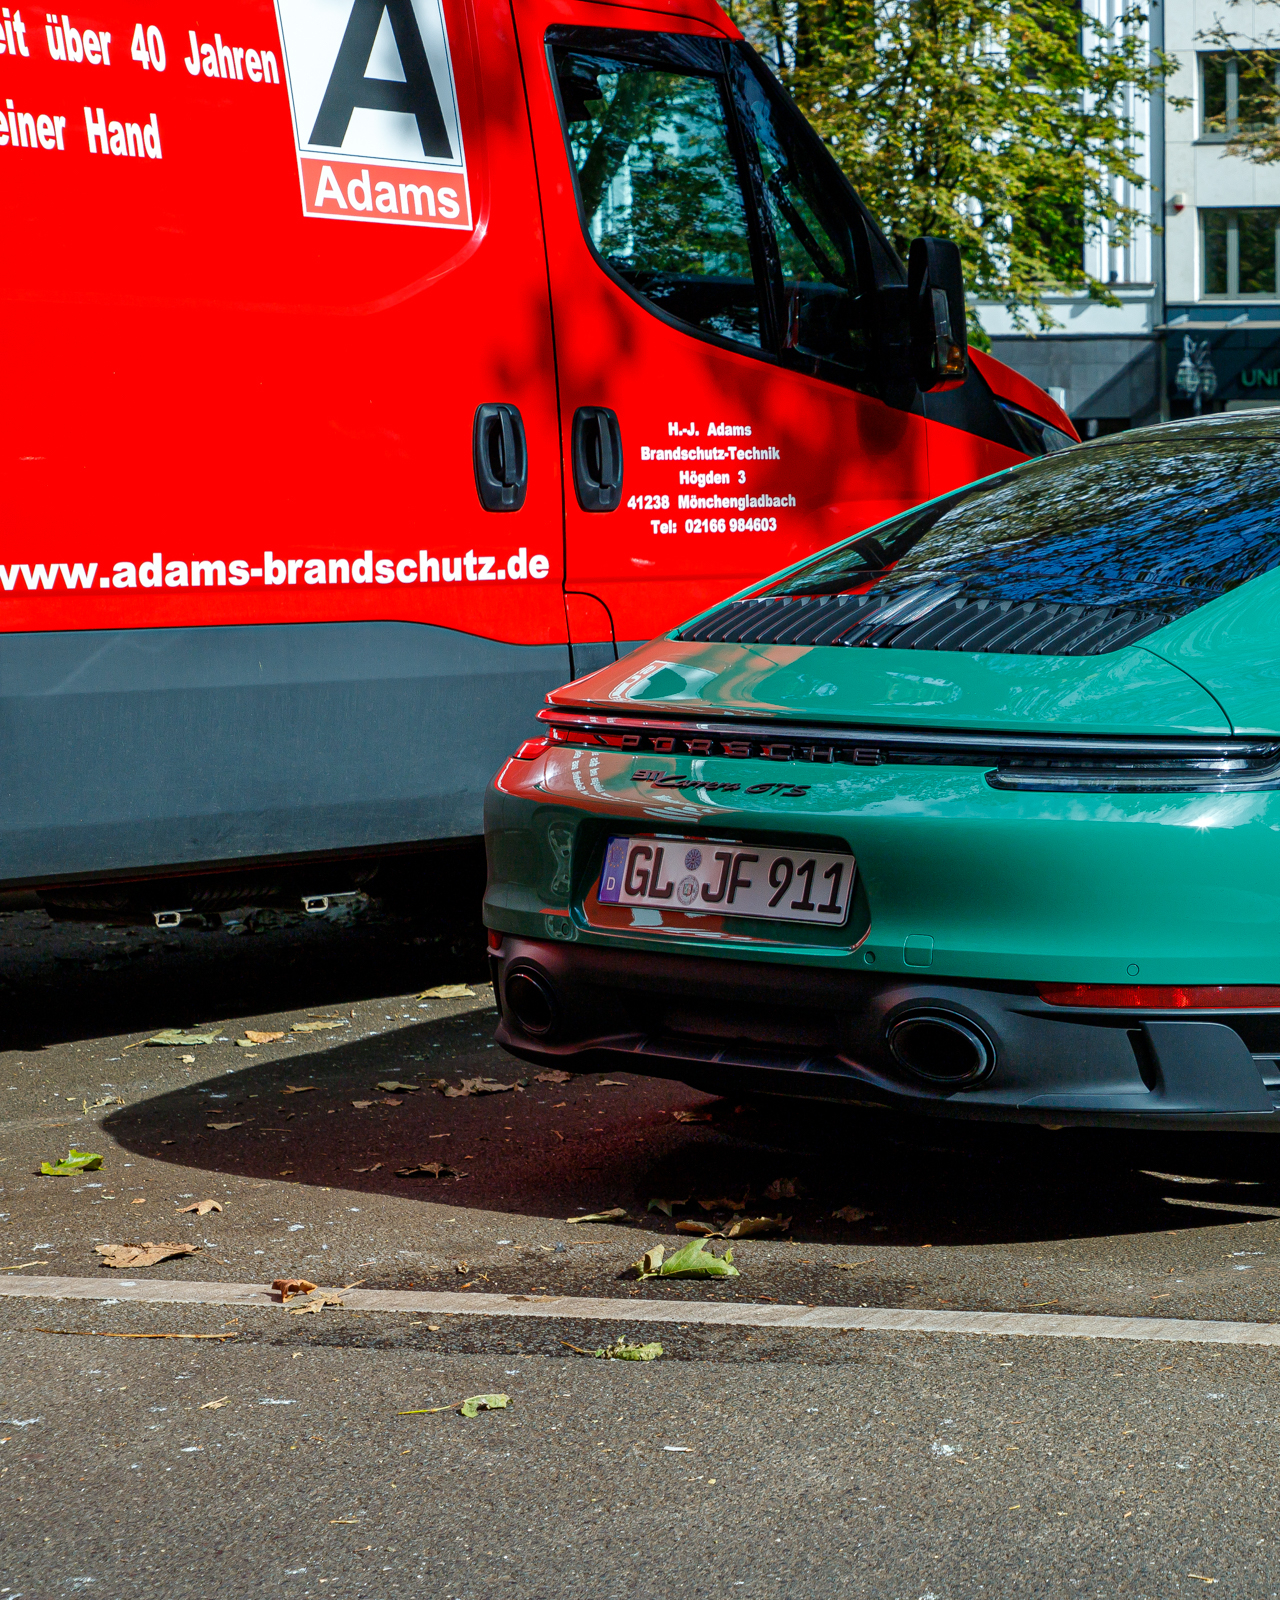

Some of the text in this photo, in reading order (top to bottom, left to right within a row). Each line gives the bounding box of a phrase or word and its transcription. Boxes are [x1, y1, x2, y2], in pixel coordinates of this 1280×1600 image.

[45, 13, 111, 65] über
[131, 23, 166, 72] 40
[185, 31, 280, 84] Jahren
[308, 0, 454, 159] A
[84, 106, 162, 159] Hand
[314, 165, 460, 219] Adams
[668, 422, 752, 436] H.-J. Adams
[641, 446, 780, 460] Brandschutz-Technik
[679, 470, 746, 487] Högden 3
[627, 494, 796, 511] 41238 Mönchengladbach
[651, 517, 777, 534] Tel: 02166 984603
[621, 734, 881, 766] PORSCHE
[656, 775, 741, 792] Carrera
[746, 783, 811, 797] GTS
[606, 876, 616, 891] D
[624, 845, 674, 899] GL
[701, 851, 759, 904] JF
[768, 856, 843, 914] 911
